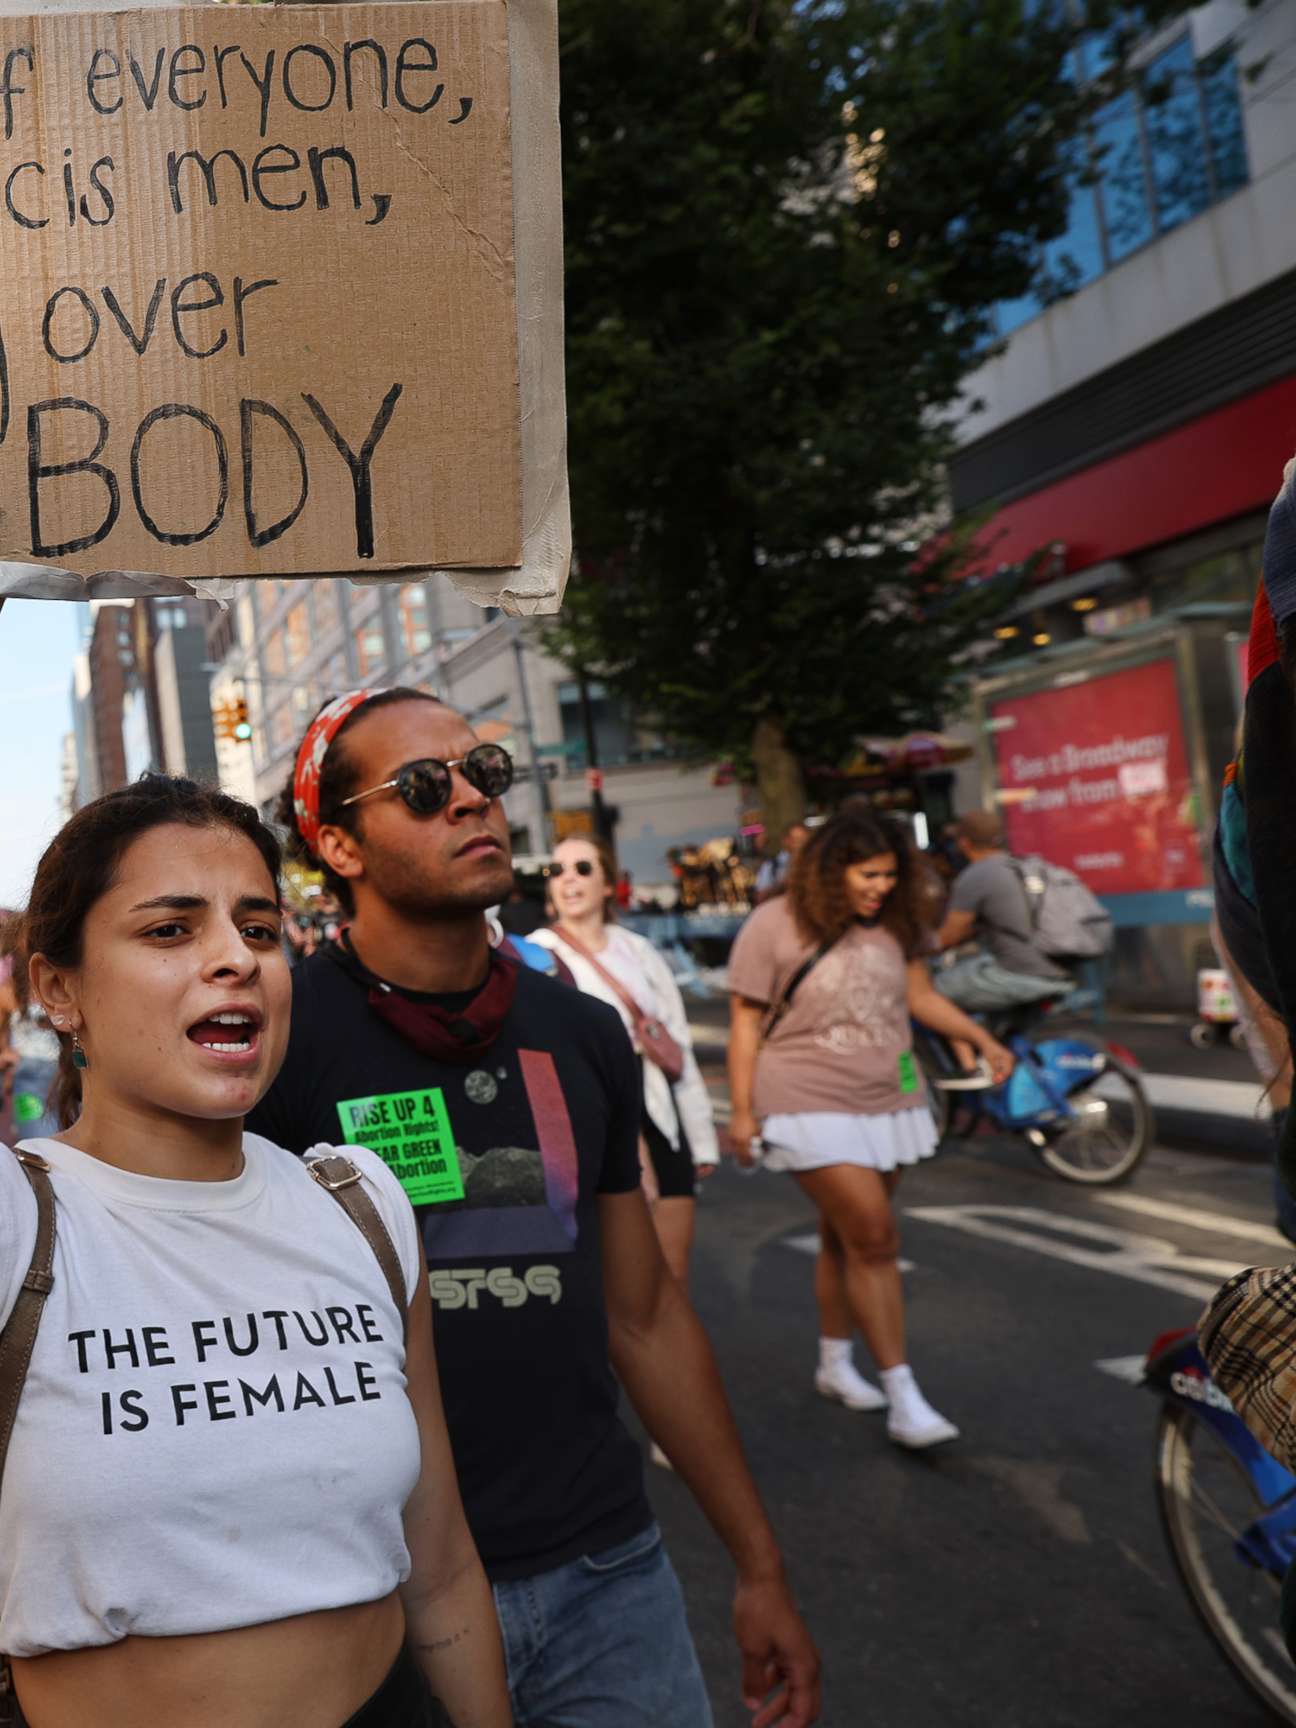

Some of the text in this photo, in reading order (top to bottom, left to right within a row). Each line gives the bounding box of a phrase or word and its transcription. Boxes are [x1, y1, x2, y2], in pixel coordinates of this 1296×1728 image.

[86, 36, 474, 140] everyone,
[4, 147, 116, 230] cis
[166, 143, 393, 226] men,
[40, 270, 281, 364] over
[26, 382, 404, 560] BODY
[349, 1094, 436, 1128] RISE UP 4
[372, 1138, 443, 1162] EAR GREEN
[67, 1303, 385, 1374] THE FUTURE
[101, 1360, 382, 1436] IS FEMALE
